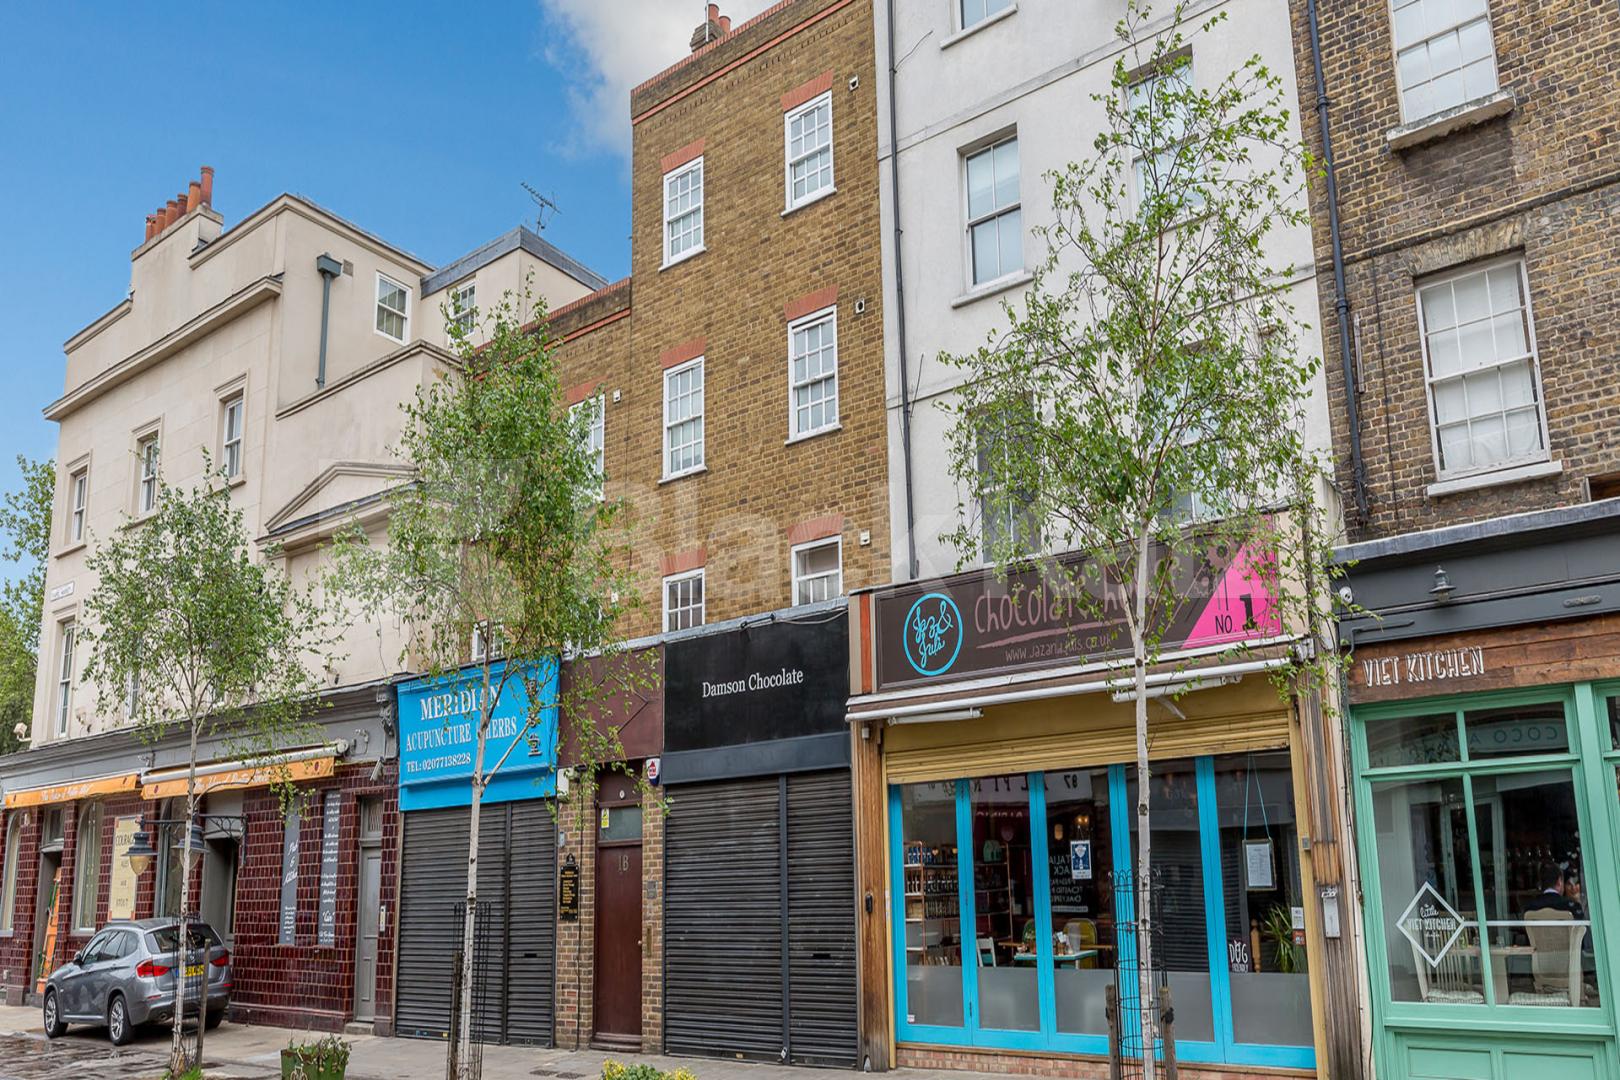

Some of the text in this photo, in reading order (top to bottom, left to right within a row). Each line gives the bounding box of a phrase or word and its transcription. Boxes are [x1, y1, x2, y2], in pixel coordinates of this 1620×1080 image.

[935, 600, 954, 634] &
[1215, 593, 1258, 634] NO. 1
[1362, 645, 1485, 688] VIET KITCHEN
[701, 667, 804, 698] Damson Chocolate
[406, 722, 472, 752] ACUPUNCTURE
[406, 760, 422, 773] TEL:
[617, 854, 629, 872] 1B
[1229, 940, 1248, 964] DOG
